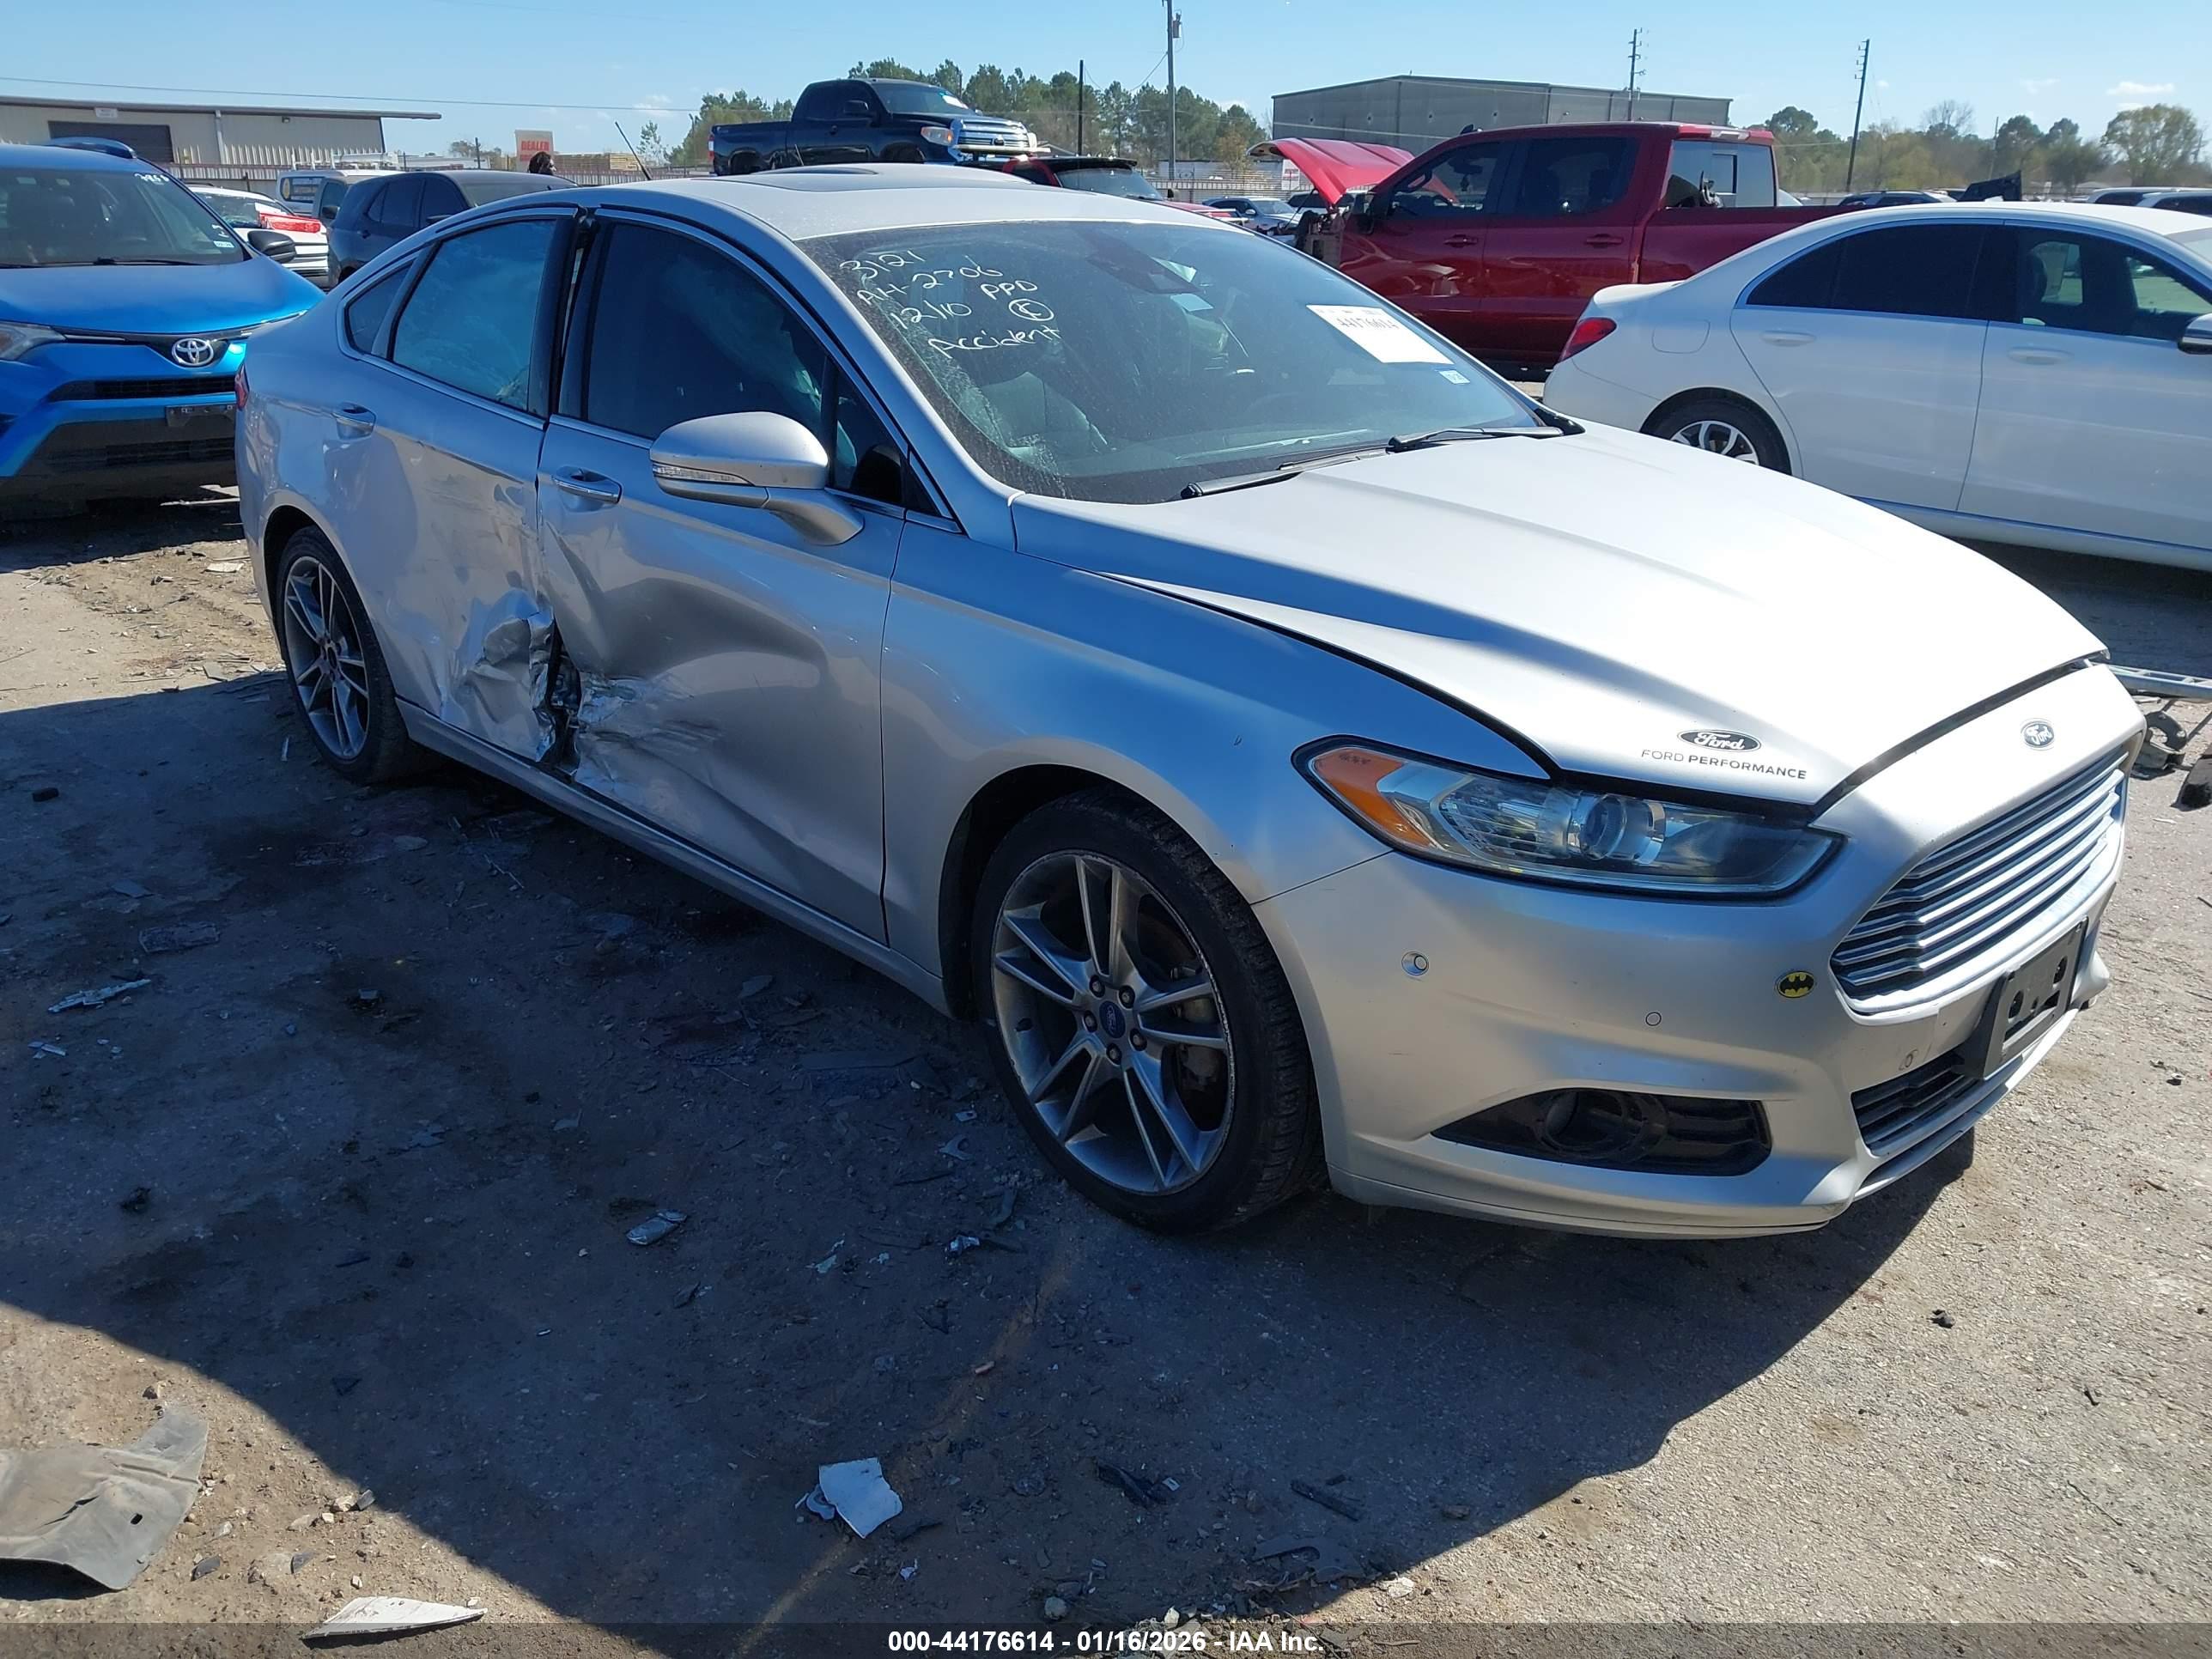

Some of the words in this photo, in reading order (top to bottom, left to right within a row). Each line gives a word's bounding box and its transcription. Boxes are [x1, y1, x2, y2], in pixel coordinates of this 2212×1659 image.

[840, 250, 926, 279] 3121
[980, 280, 1038, 300] PPD
[890, 300, 972, 329] 12/10
[927, 325, 1061, 359] Accident
[1692, 730, 1747, 751] Ford
[1641, 749, 1685, 763] FORD
[1688, 755, 1808, 780] PERFORMANCE
